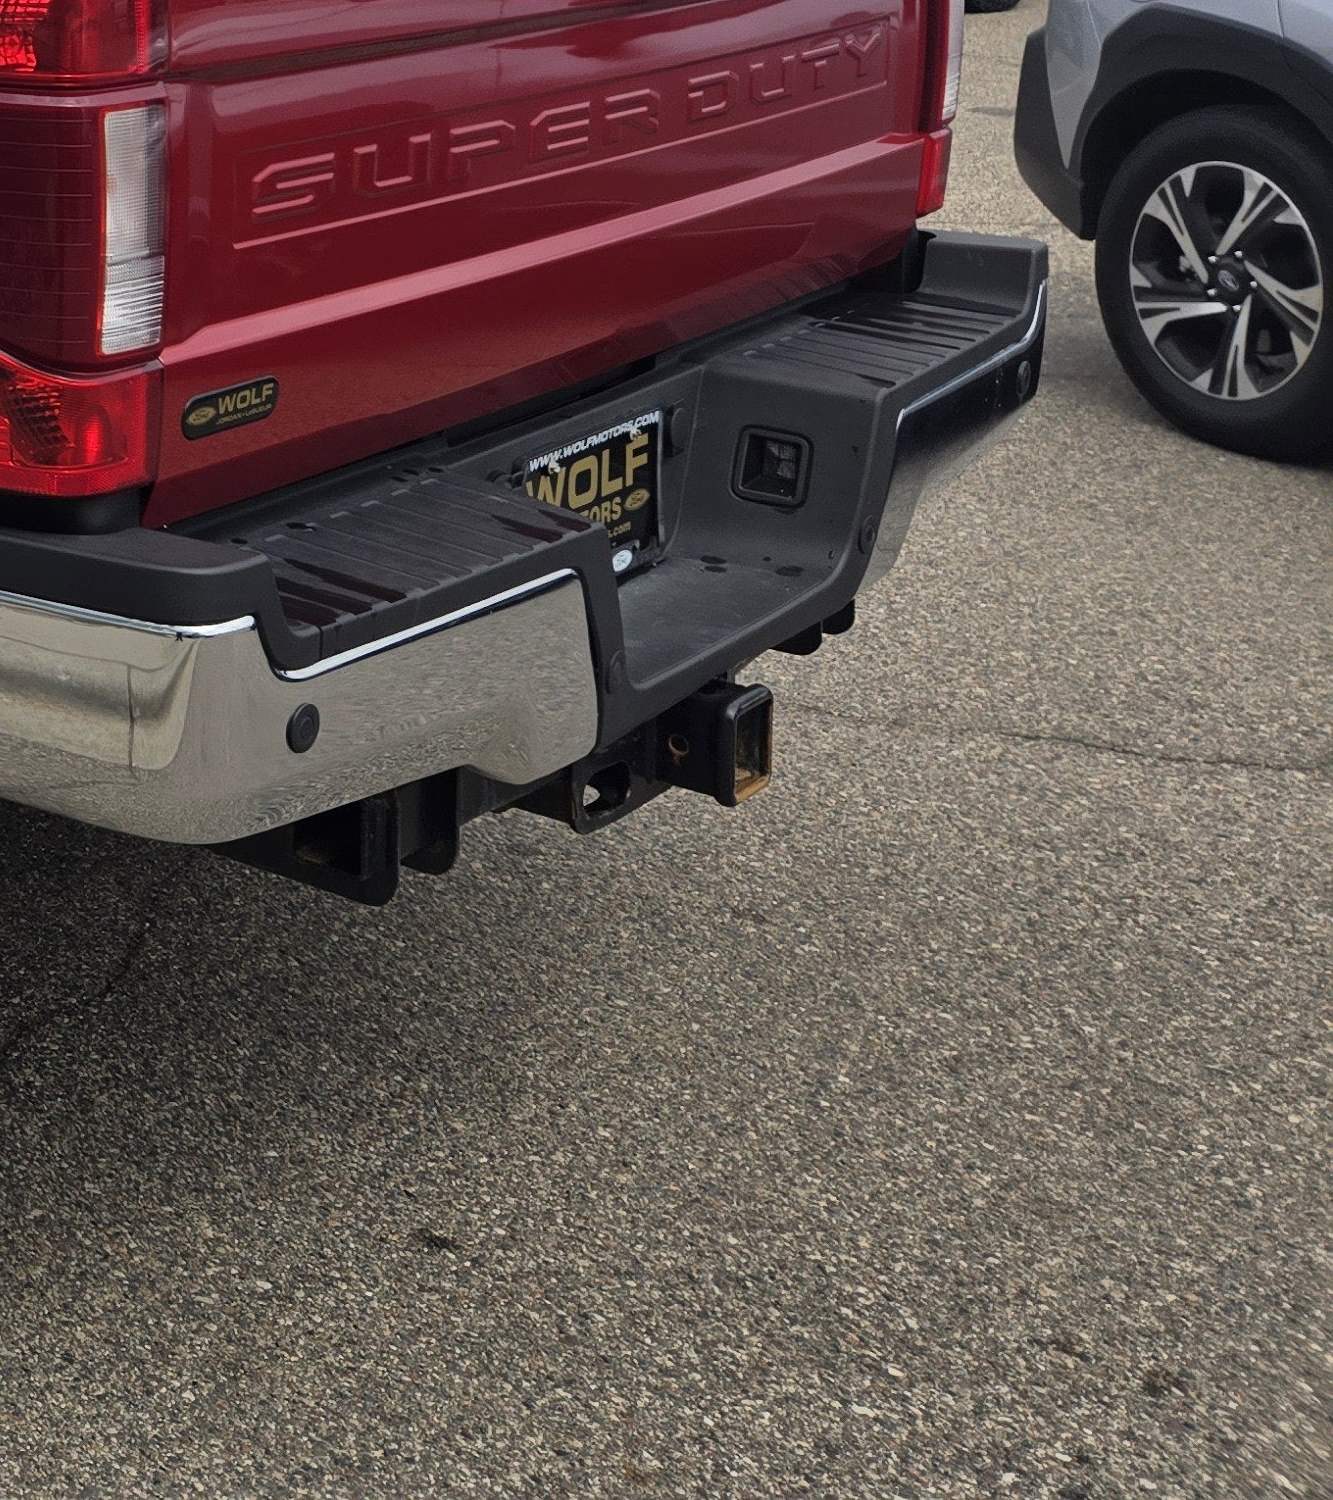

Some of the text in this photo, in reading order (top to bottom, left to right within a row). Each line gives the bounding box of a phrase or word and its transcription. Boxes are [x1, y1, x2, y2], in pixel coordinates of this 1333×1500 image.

[252, 27, 884, 224] SUPER DUTY
[218, 383, 274, 415] WOLF
[525, 433, 649, 510] WOLF
